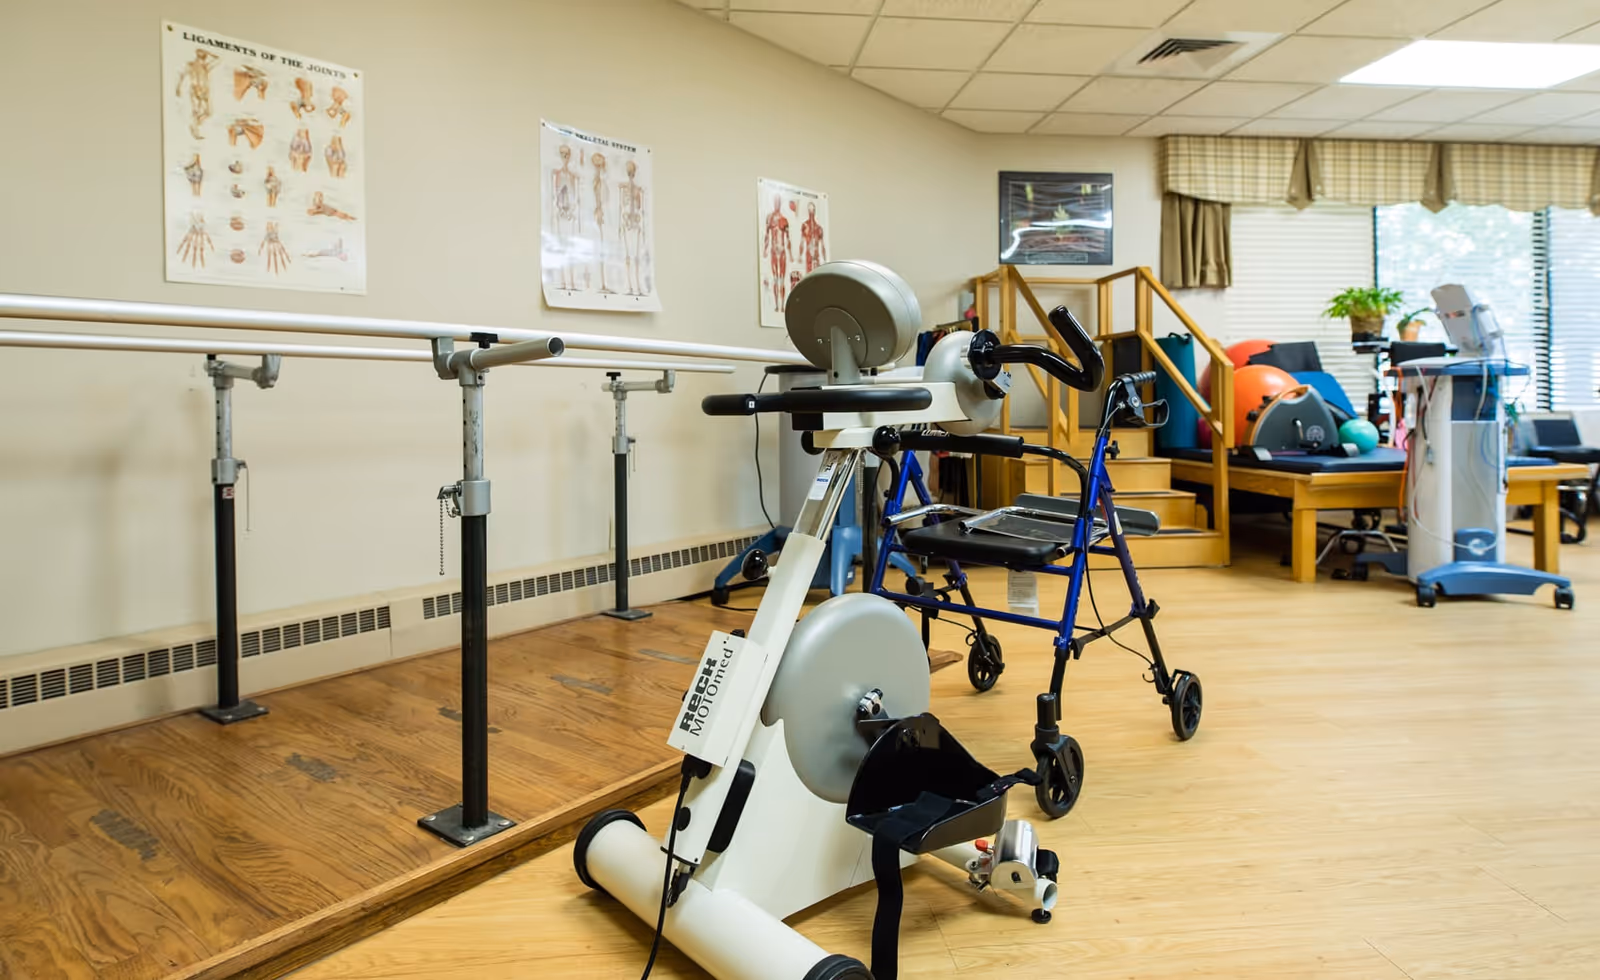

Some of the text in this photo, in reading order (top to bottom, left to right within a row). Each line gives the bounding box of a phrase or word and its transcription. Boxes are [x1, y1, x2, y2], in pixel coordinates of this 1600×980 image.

[183, 32, 346, 79] LIGAMENTS OF THE JOINTS
[612, 142, 636, 153] SYSTEM
[689, 648, 733, 736] MOTOmed
